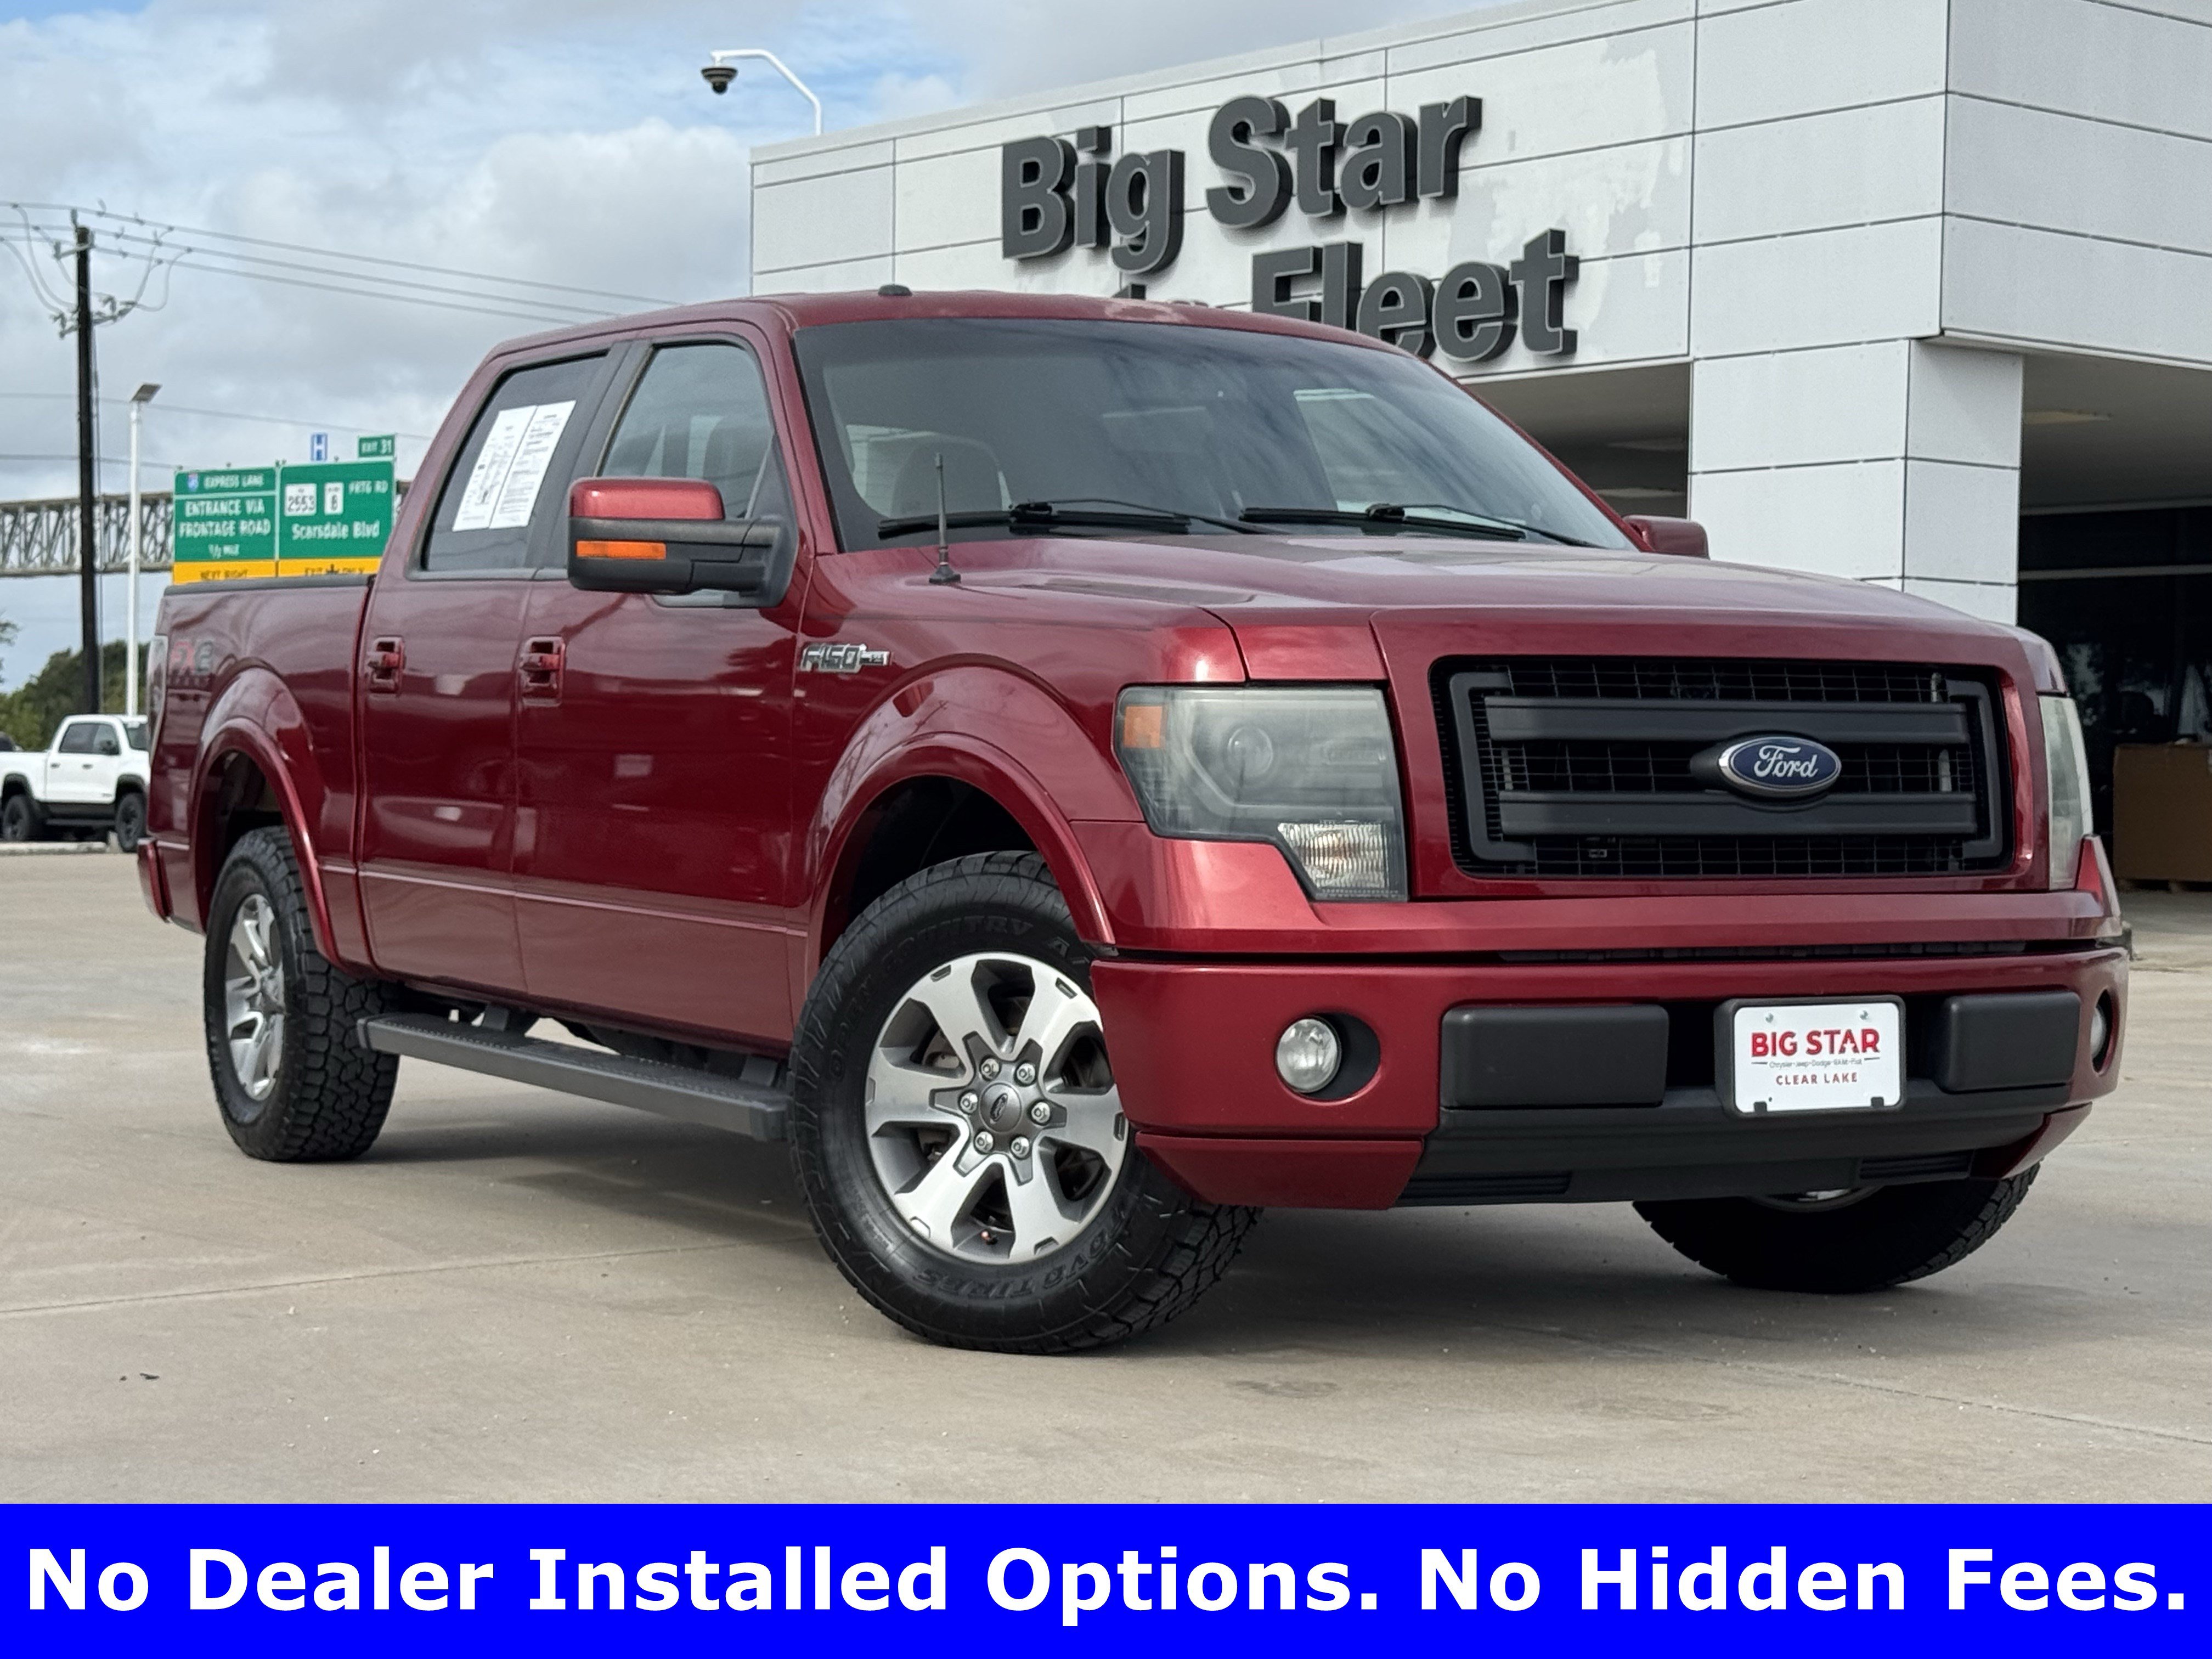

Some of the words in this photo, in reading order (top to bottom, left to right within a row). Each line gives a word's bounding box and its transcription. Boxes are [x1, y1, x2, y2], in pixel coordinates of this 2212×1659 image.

[1002, 125, 1185, 273] Big
[1206, 94, 1482, 230] Star
[1251, 228, 1579, 362] Fleet
[204, 475, 239, 489] EXPRESS
[242, 473, 264, 487] LANE
[185, 499, 241, 517] ENTRANCE
[246, 498, 265, 515] VIA
[287, 495, 314, 512] 2553
[179, 520, 236, 538] FRONTAGE
[240, 518, 271, 537] ROAD
[292, 521, 349, 540] Scarsdale
[353, 520, 380, 539] Blvd
[1754, 745, 1818, 777] Ford
[1751, 1031, 1797, 1057] BIG
[1806, 1028, 1880, 1054] STAR
[1776, 1074, 1818, 1085] CLEAR
[1824, 1072, 1858, 1083] LAKE
